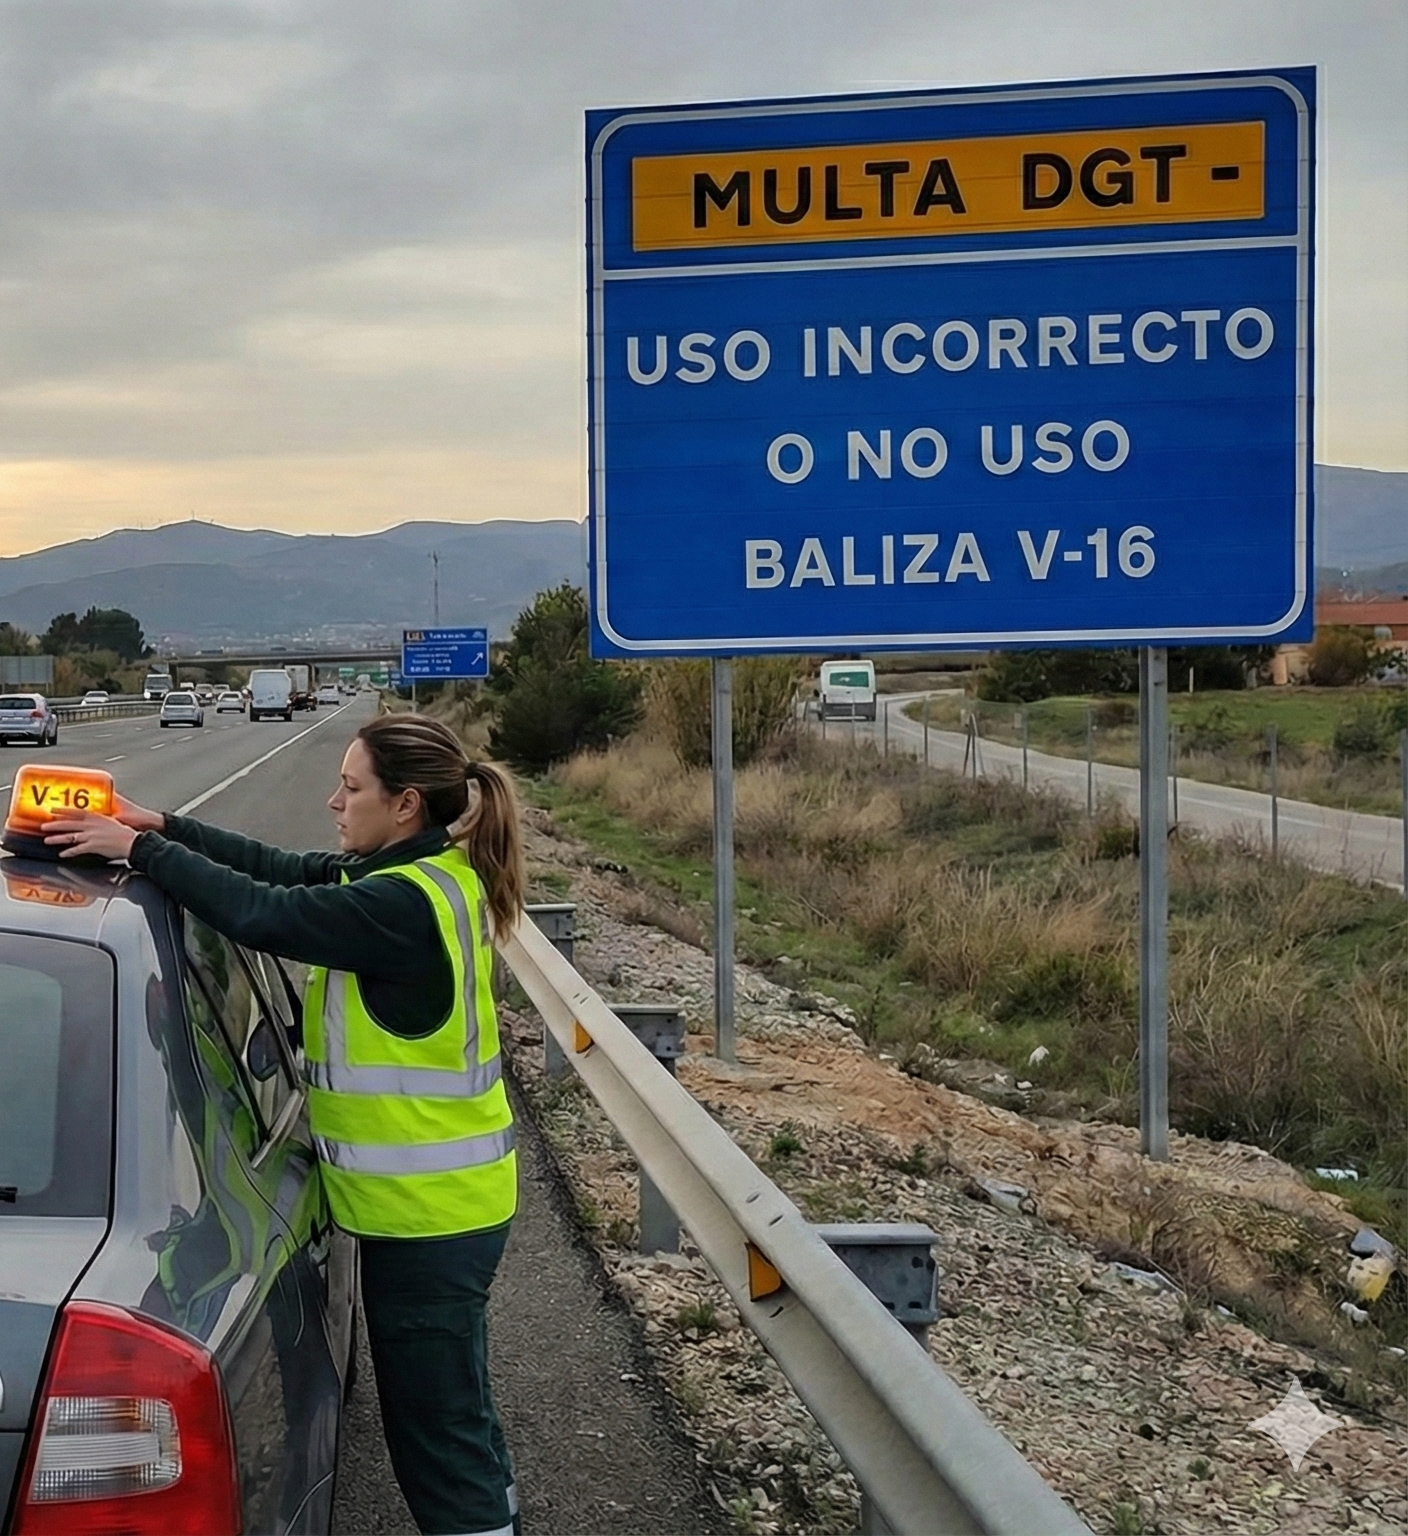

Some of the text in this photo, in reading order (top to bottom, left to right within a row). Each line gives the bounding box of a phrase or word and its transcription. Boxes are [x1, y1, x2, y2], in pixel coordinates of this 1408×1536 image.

[693, 157, 966, 228] MULTA
[626, 307, 1275, 386] USO INCORRECTO
[766, 419, 1130, 484] O NO USO
[745, 526, 1156, 589] BALIZA V-16
[31, 784, 90, 809] V-16
